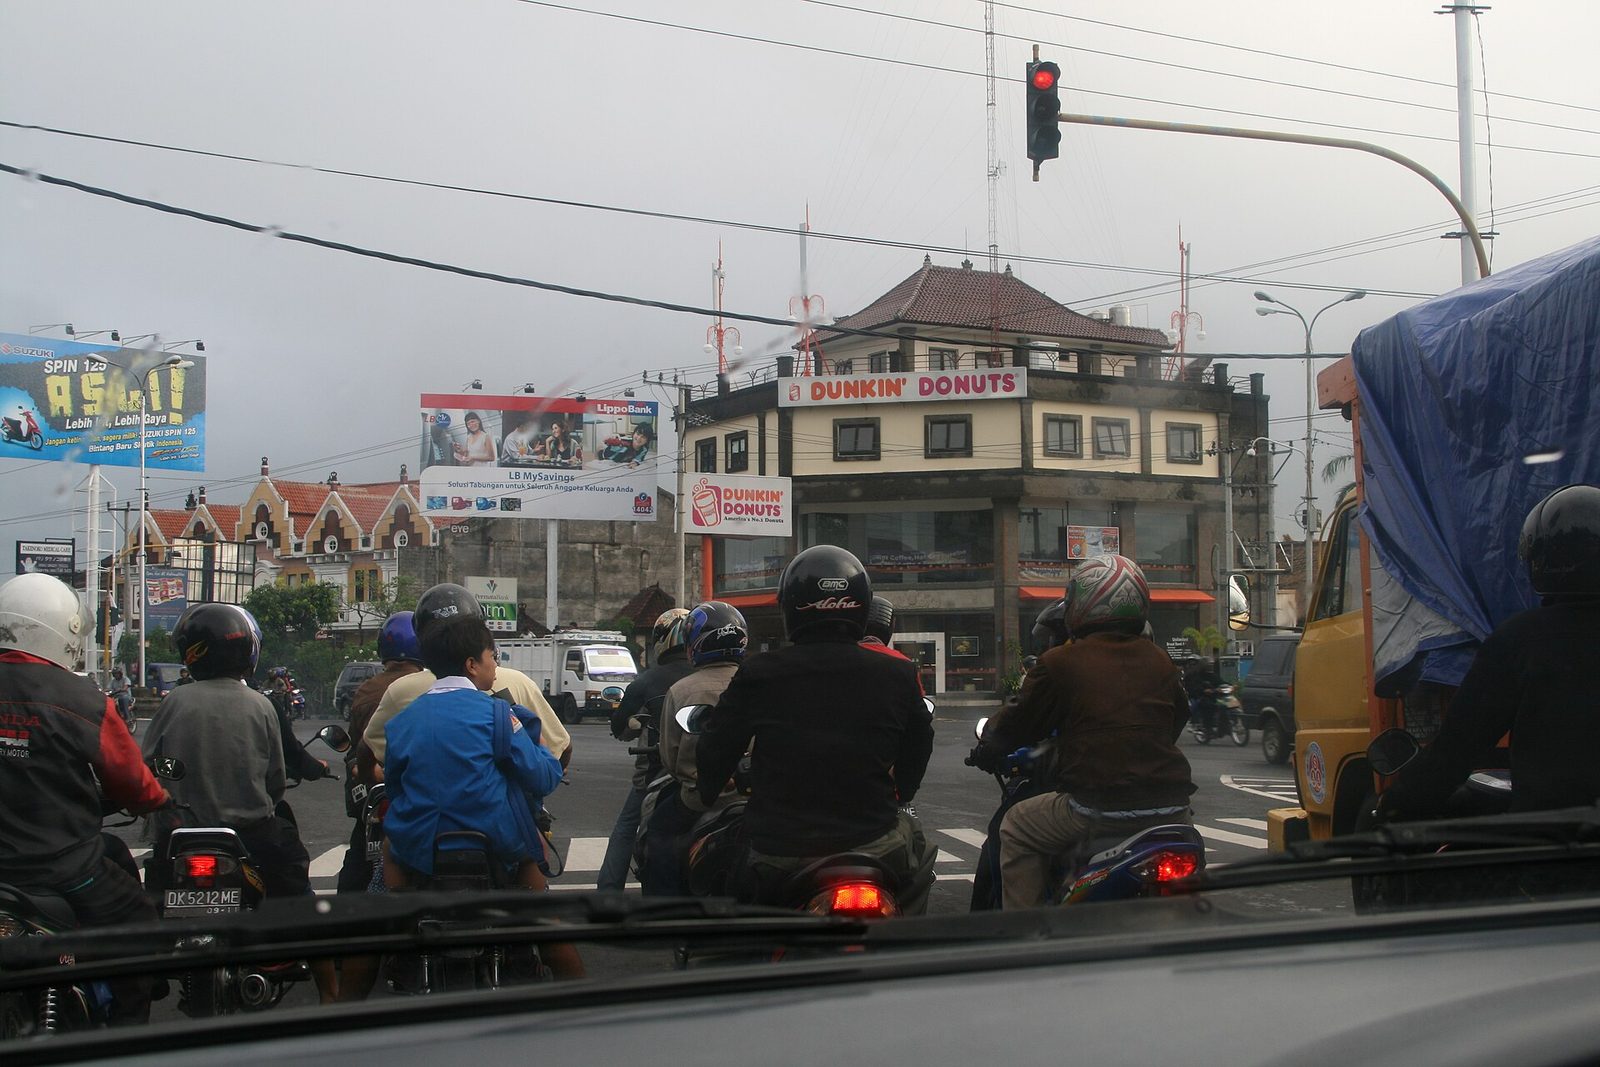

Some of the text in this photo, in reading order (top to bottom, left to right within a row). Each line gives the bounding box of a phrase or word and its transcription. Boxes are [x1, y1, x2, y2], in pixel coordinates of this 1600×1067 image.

[13, 346, 55, 358] SUZUKI
[44, 359, 107, 373] SPIN 125
[811, 373, 1016, 401] DUNKIN' DONUTS
[597, 403, 652, 415] LippoBank
[65, 417, 92, 430] Lebih
[114, 414, 140, 427] Lebih
[144, 413, 167, 427] Gaya
[165, 428, 182, 436] SPIN
[184, 427, 196, 435] 125
[88, 444, 114, 453] Bintang
[115, 442, 132, 451] Baru
[509, 471, 575, 484] LB MySavings
[470, 481, 504, 490] Tabungan
[527, 482, 553, 490] Seluruh
[554, 484, 584, 493] Anggota
[584, 484, 615, 494] Keluarga
[616, 485, 634, 493] Anda
[723, 487, 784, 503] DUNKIN'
[723, 502, 781, 517] DONUTS
[796, 596, 862, 610] Aloha
[7, 749, 30, 758] MOTOR
[168, 890, 240, 906] DK 5212 ME
